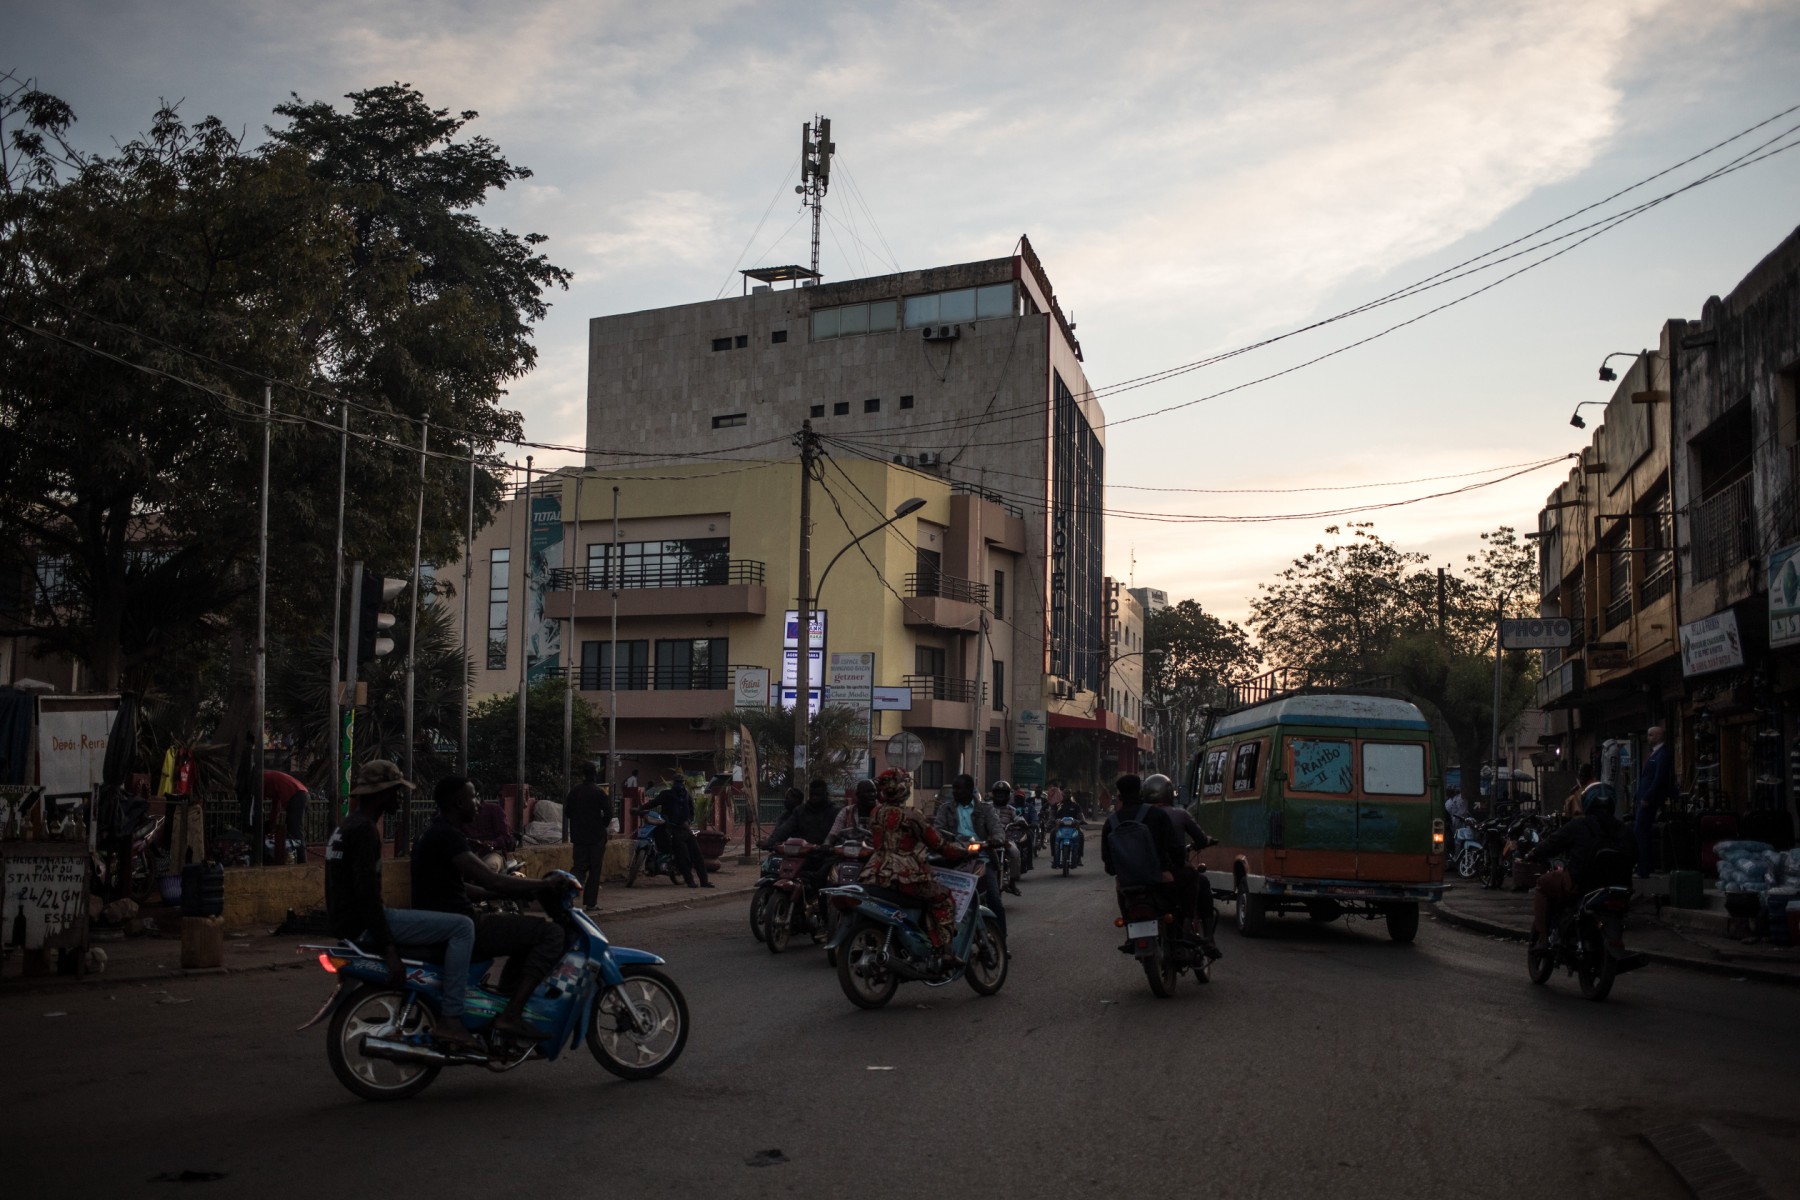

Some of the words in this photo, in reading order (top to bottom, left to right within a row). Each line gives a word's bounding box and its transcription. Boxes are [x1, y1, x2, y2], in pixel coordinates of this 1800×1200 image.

[1503, 620, 1569, 637] PHOTO
[834, 672, 865, 684] getzner
[1300, 748, 1341, 776] RAMBO
[35, 865, 73, 874] PAPOU
[7, 873, 54, 884] STATION
